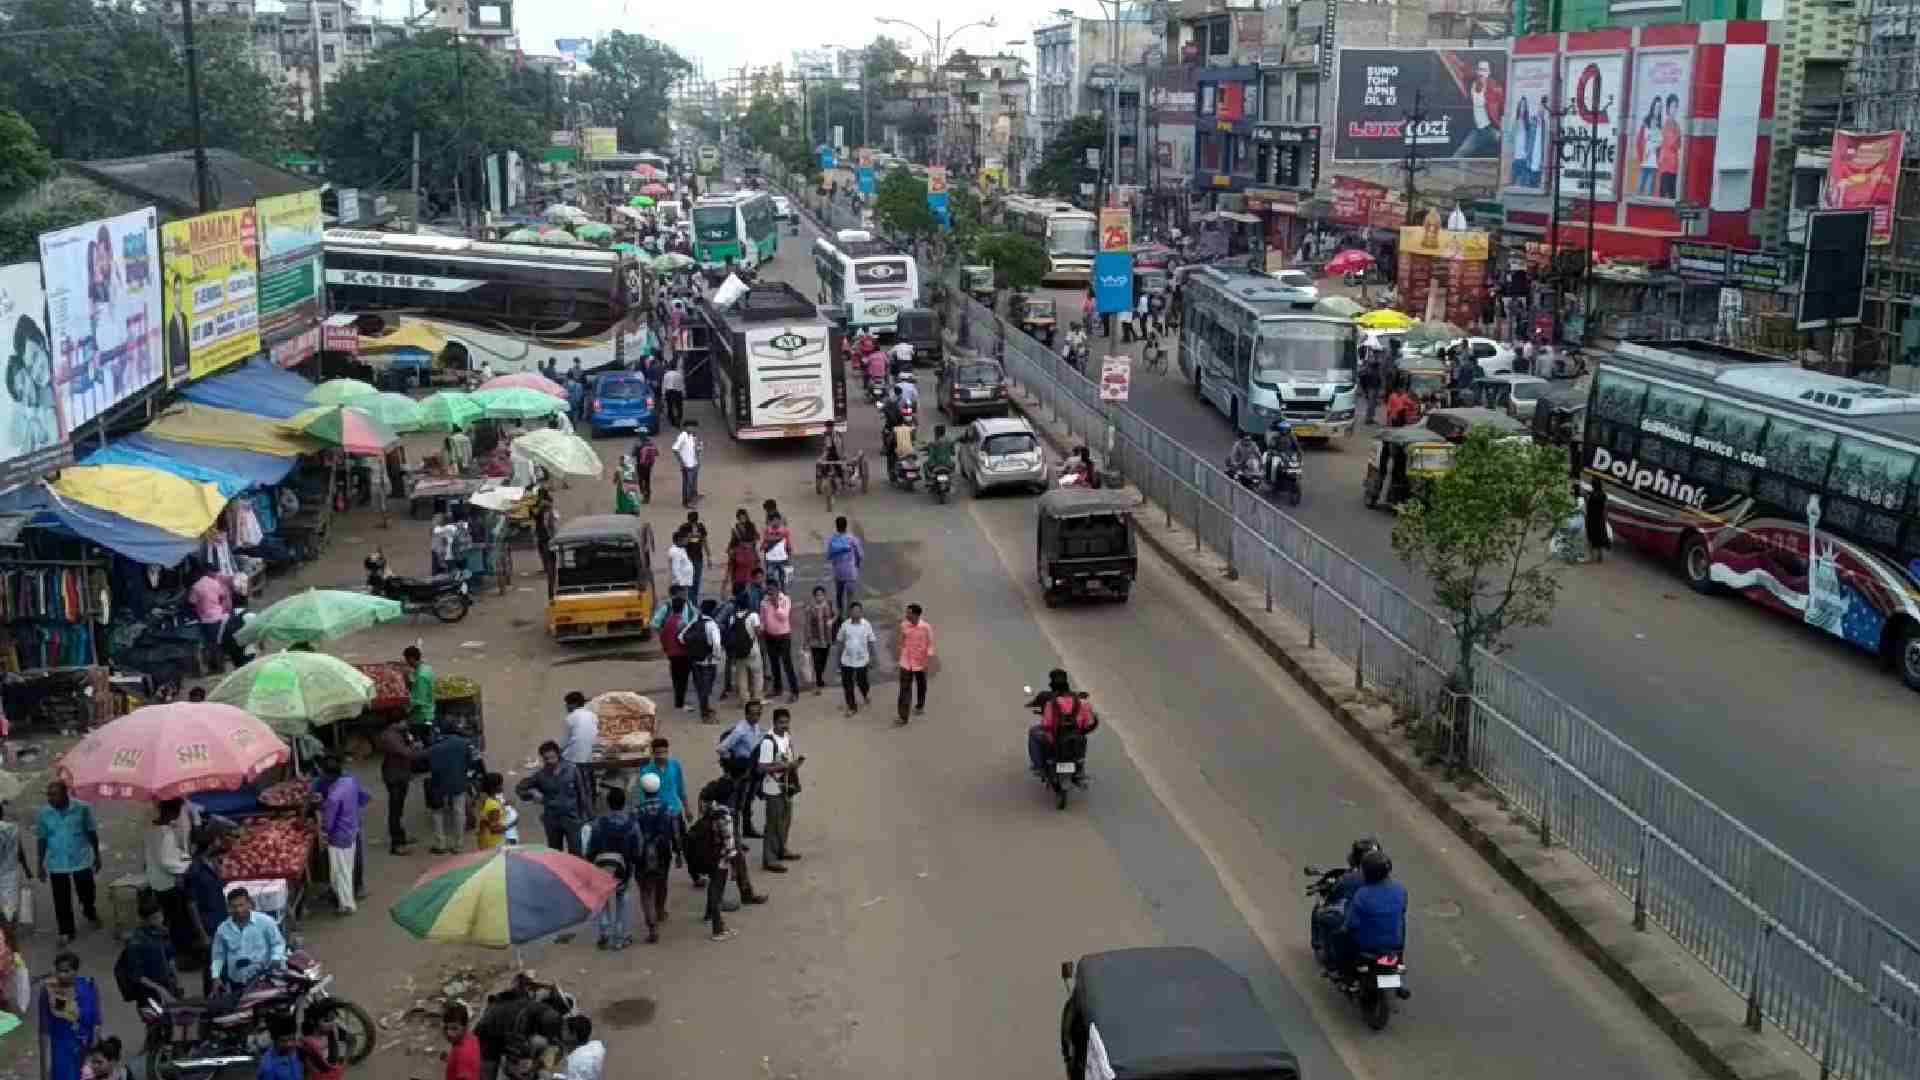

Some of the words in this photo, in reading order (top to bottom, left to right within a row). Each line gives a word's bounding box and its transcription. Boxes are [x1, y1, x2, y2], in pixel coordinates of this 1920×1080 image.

[1367, 66, 1398, 77] SUNO
[1367, 77, 1389, 87] TOH
[1367, 87, 1396, 96] APNE
